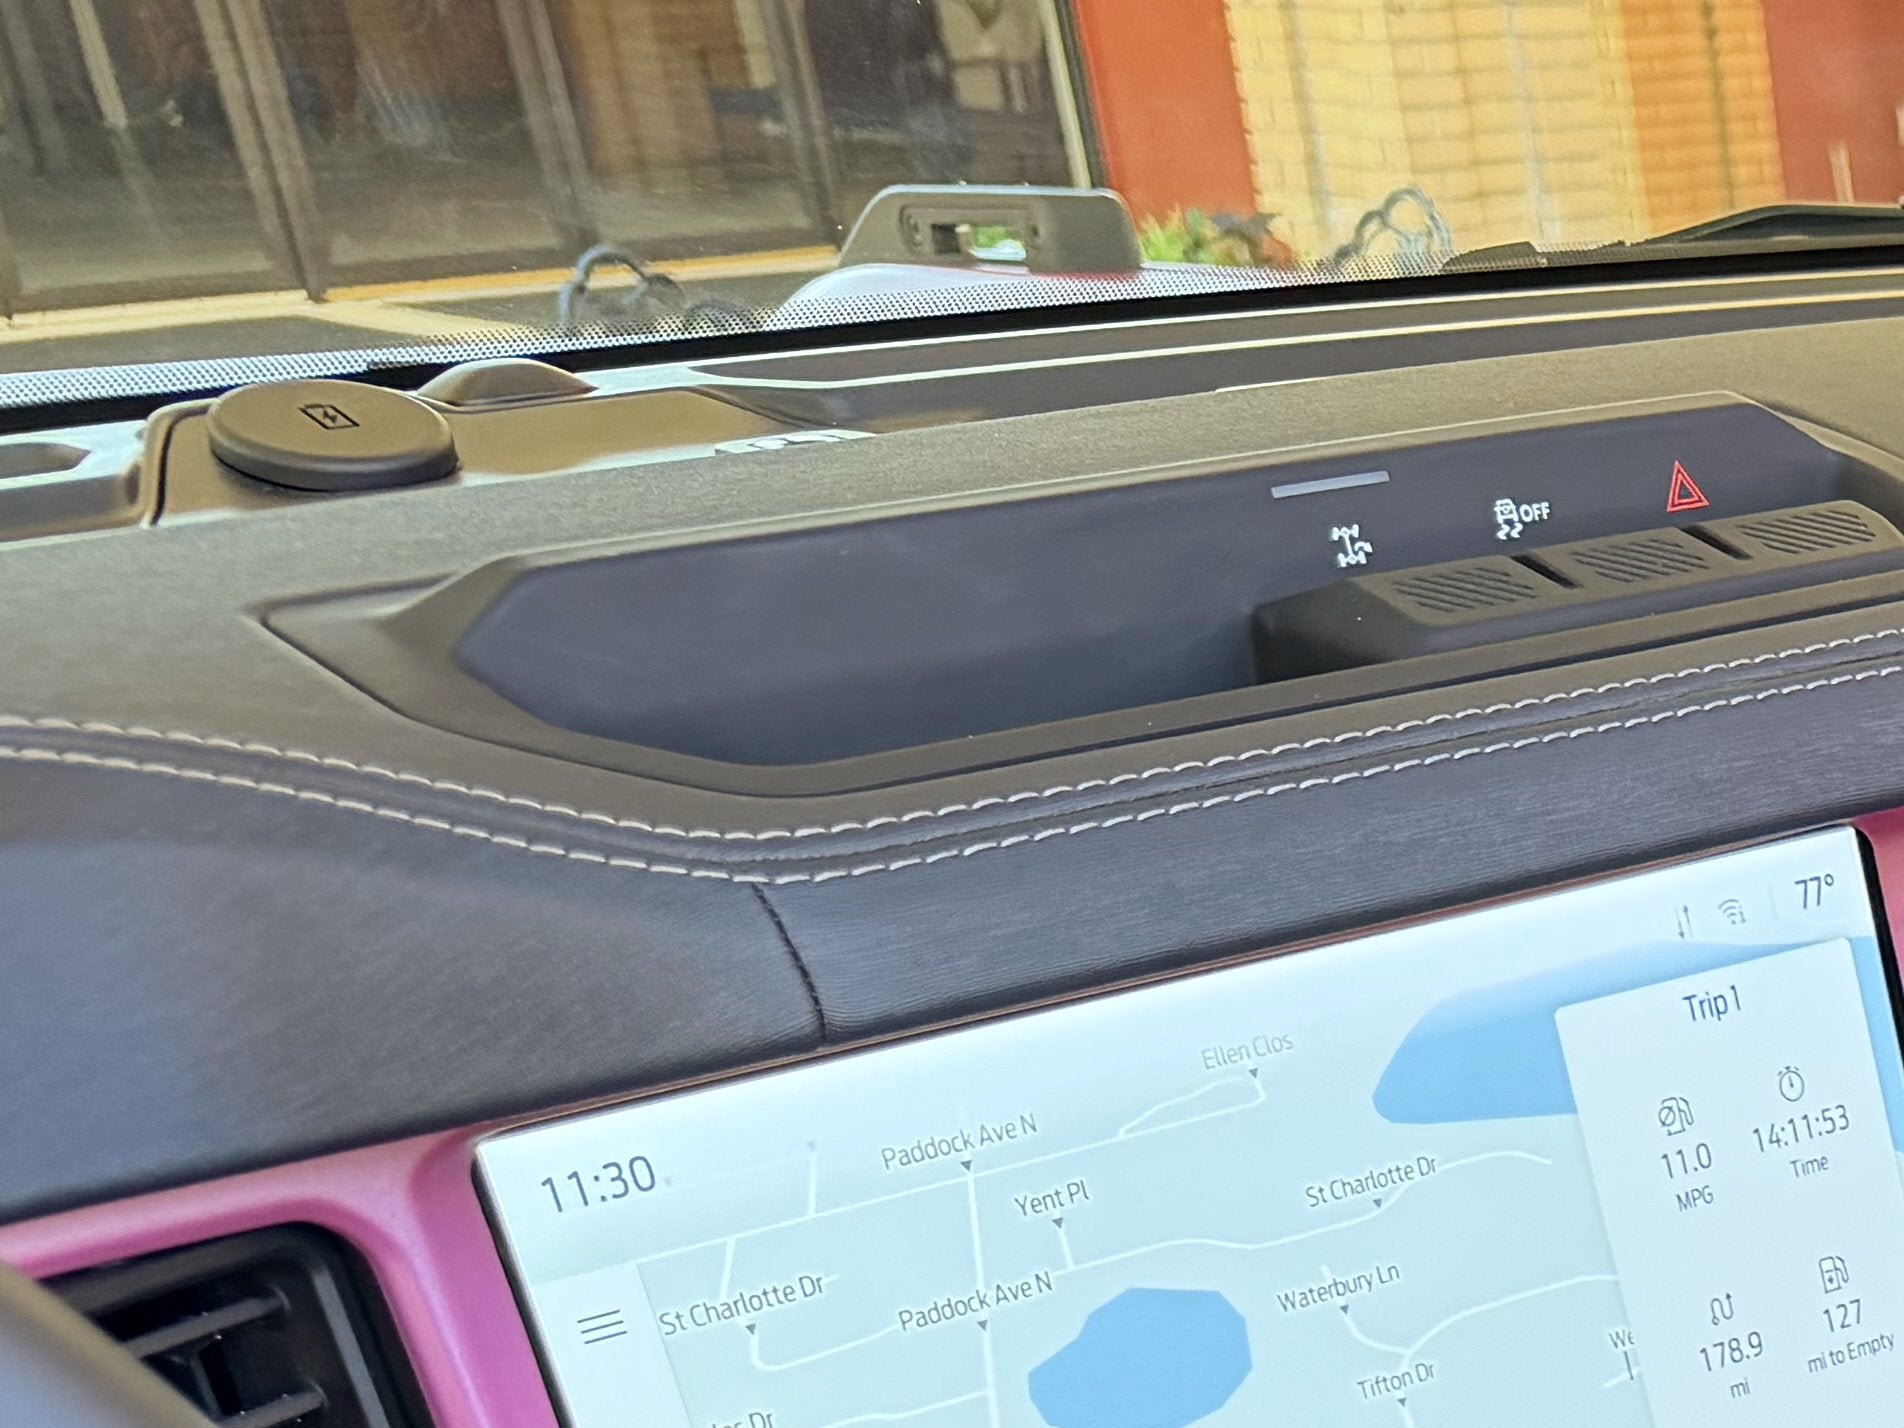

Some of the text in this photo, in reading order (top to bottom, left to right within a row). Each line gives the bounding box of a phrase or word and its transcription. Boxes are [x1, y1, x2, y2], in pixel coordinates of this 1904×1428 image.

[1519, 502, 1550, 522] OFF
[1202, 1034, 1294, 1069] Ellen Clos
[882, 1113, 1038, 1169] Paddock Ave N
[1752, 1105, 1850, 1154] 14:11:53
[1661, 1142, 1712, 1180] 11.0
[1790, 1153, 1829, 1179] Time
[541, 1155, 657, 1213] 11:30
[1014, 1179, 1089, 1218] Yent Pl
[1305, 1156, 1437, 1208] St Charlotte Dr
[1676, 1186, 1714, 1213] MPG
[659, 1274, 824, 1336] St Charlotte Dr
[899, 1271, 1053, 1331] Paddock Ave N
[1277, 1264, 1400, 1312] Waterbury Ln
[1822, 1299, 1862, 1333] 127
[1700, 1332, 1764, 1372] 178.9
[1808, 1333, 1895, 1374] mi to Empty
[1357, 1362, 1435, 1400] Tifton Dr
[1730, 1378, 1750, 1399] mi
